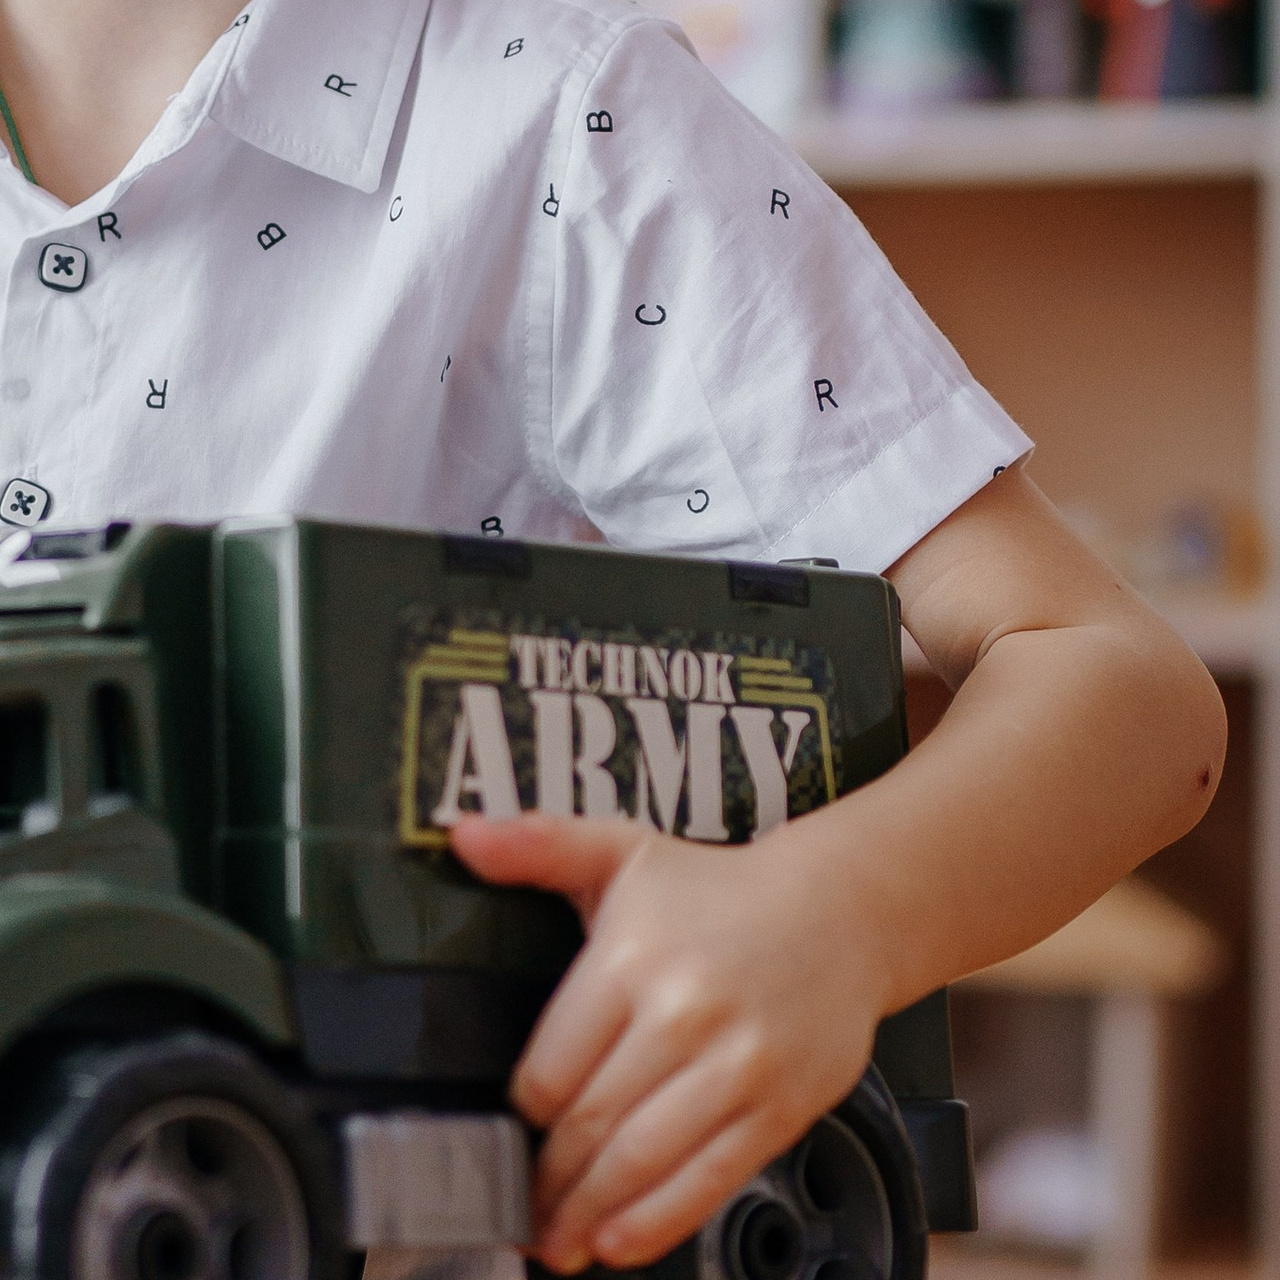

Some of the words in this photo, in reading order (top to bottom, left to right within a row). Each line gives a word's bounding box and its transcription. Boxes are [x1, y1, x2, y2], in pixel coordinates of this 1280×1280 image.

[503, 37, 524, 58] B
[323, 72, 357, 97] R
[586, 109, 613, 132] B
[389, 195, 403, 222] C
[770, 188, 790, 219] R
[96, 211, 121, 242] R
[256, 222, 287, 250] B
[634, 303, 666, 325] C
[145, 378, 168, 409] R
[813, 378, 838, 412] R
[686, 488, 709, 513] C
[510, 632, 736, 704] TECHNOK
[431, 683, 811, 841] ARMY
